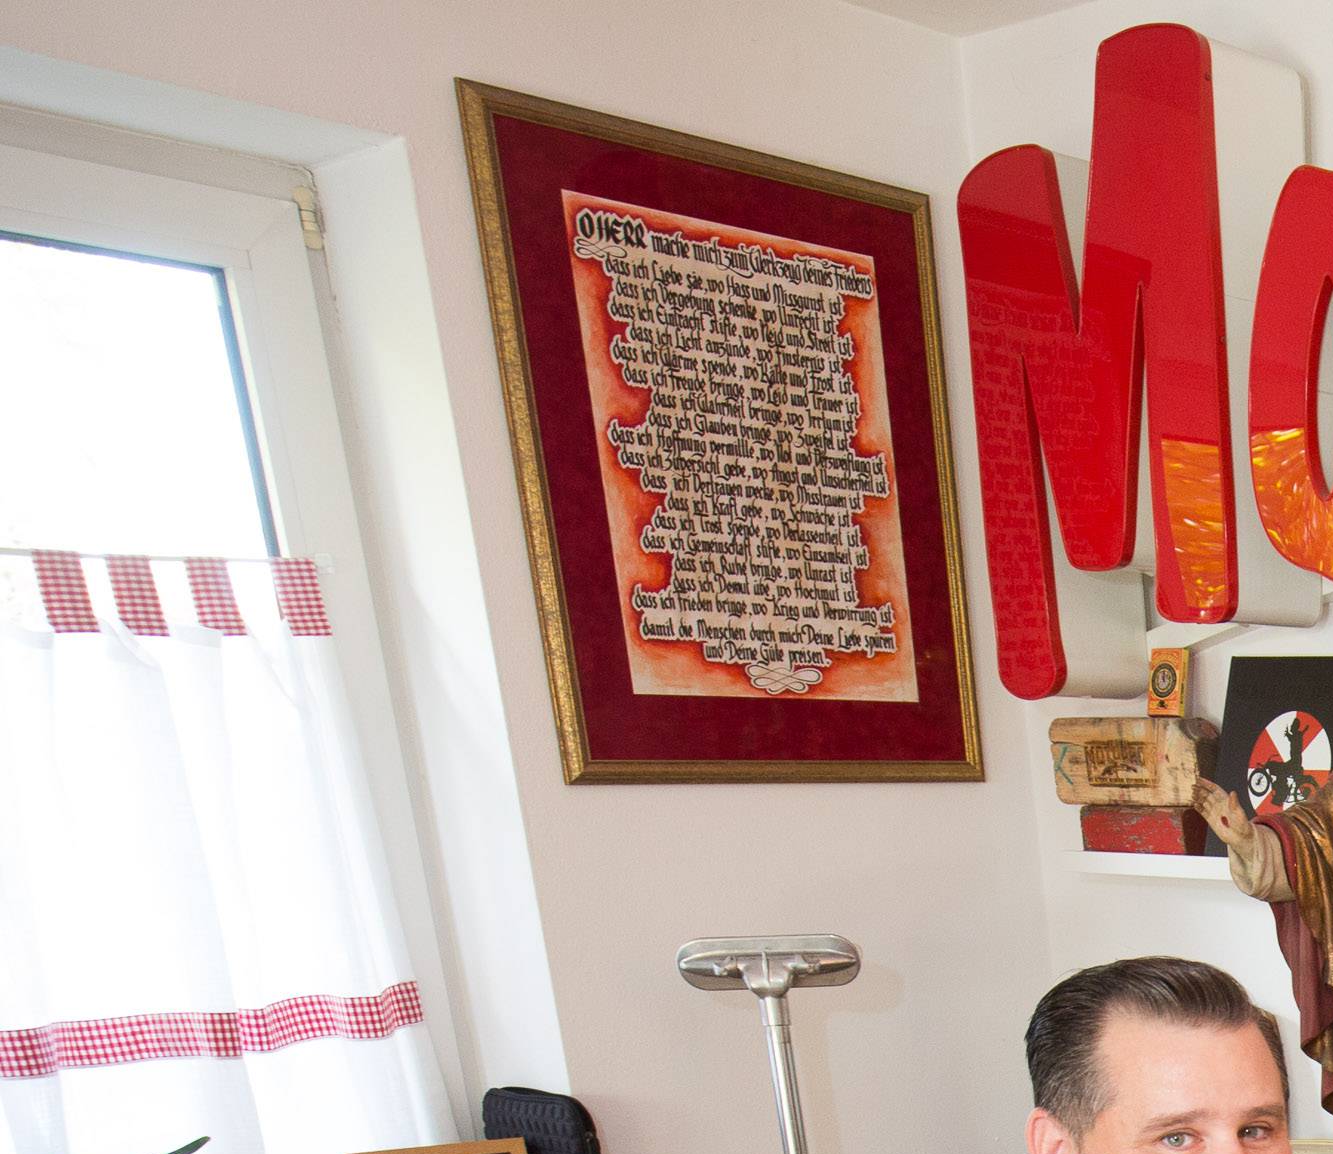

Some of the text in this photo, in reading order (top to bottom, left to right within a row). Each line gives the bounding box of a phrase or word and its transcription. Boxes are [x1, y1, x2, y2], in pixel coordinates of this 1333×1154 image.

[578, 212, 595, 239] O
[596, 216, 646, 249] HERR
[632, 262, 650, 280] ich
[751, 286, 772, 303] und
[828, 295, 843, 317] ist
[636, 304, 655, 323] ich
